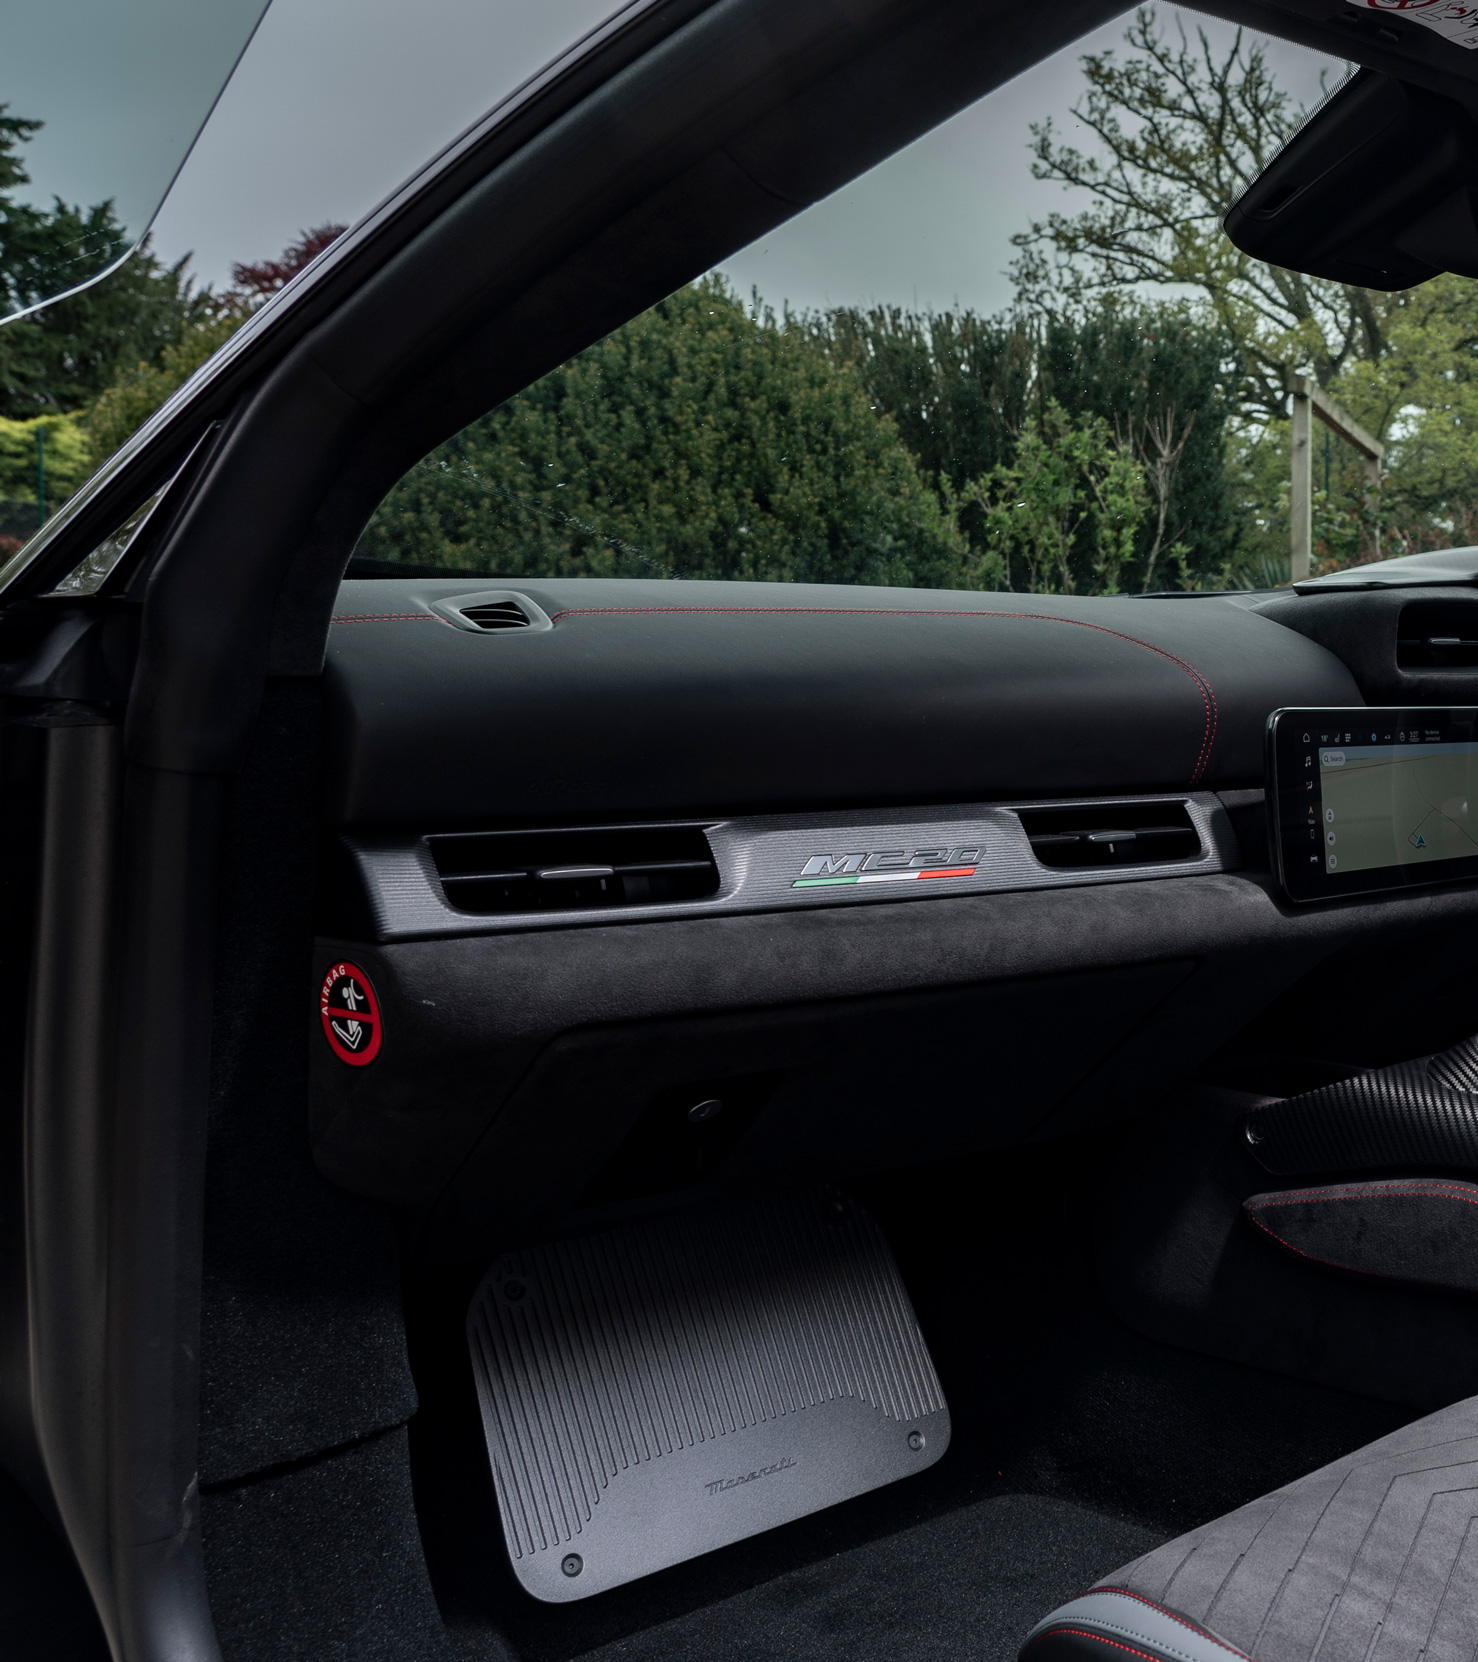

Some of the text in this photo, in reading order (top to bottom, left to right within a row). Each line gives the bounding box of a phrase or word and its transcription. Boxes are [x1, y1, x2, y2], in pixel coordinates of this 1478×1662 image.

[800, 846, 987, 876] MC20
[321, 964, 346, 1016] AIRBAG
[704, 1457, 798, 1495] Maserati
